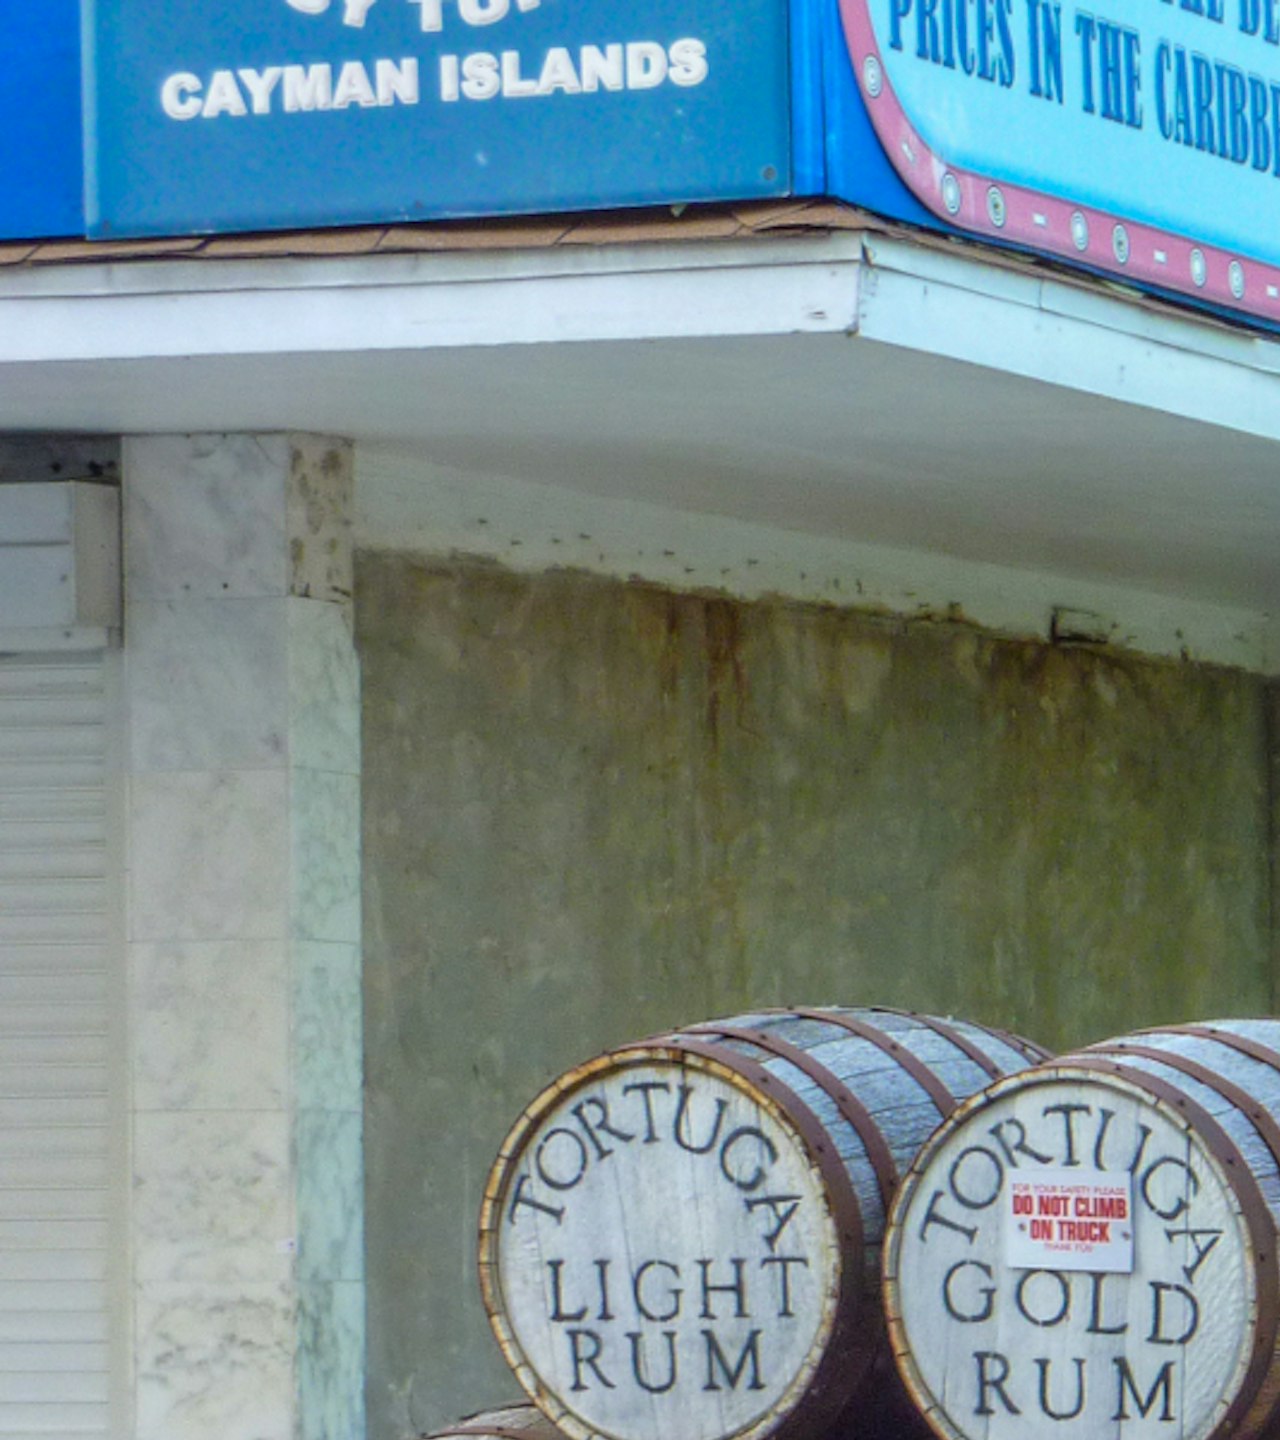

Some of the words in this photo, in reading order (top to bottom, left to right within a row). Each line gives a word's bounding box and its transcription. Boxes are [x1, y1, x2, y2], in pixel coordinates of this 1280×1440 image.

[161, 57, 419, 121] CAYMAN
[440, 38, 708, 101] ISLANDS
[1028, 0, 1065, 105] IN
[1075, 9, 1144, 130] THE
[509, 1081, 805, 1252] TORTUGA
[919, 1103, 1227, 1282] TORTUGA
[1012, 1194, 1033, 1215] DO
[1037, 1195, 1070, 1217] NOT
[1074, 1196, 1126, 1219] CLIMB
[1030, 1218, 1053, 1240] ON
[1058, 1220, 1110, 1243] TRUCK
[547, 1257, 808, 1323] LIGHT
[942, 1260, 1199, 1346] GOLD
[570, 1329, 767, 1393] RUM
[974, 1352, 1177, 1423] RUM
